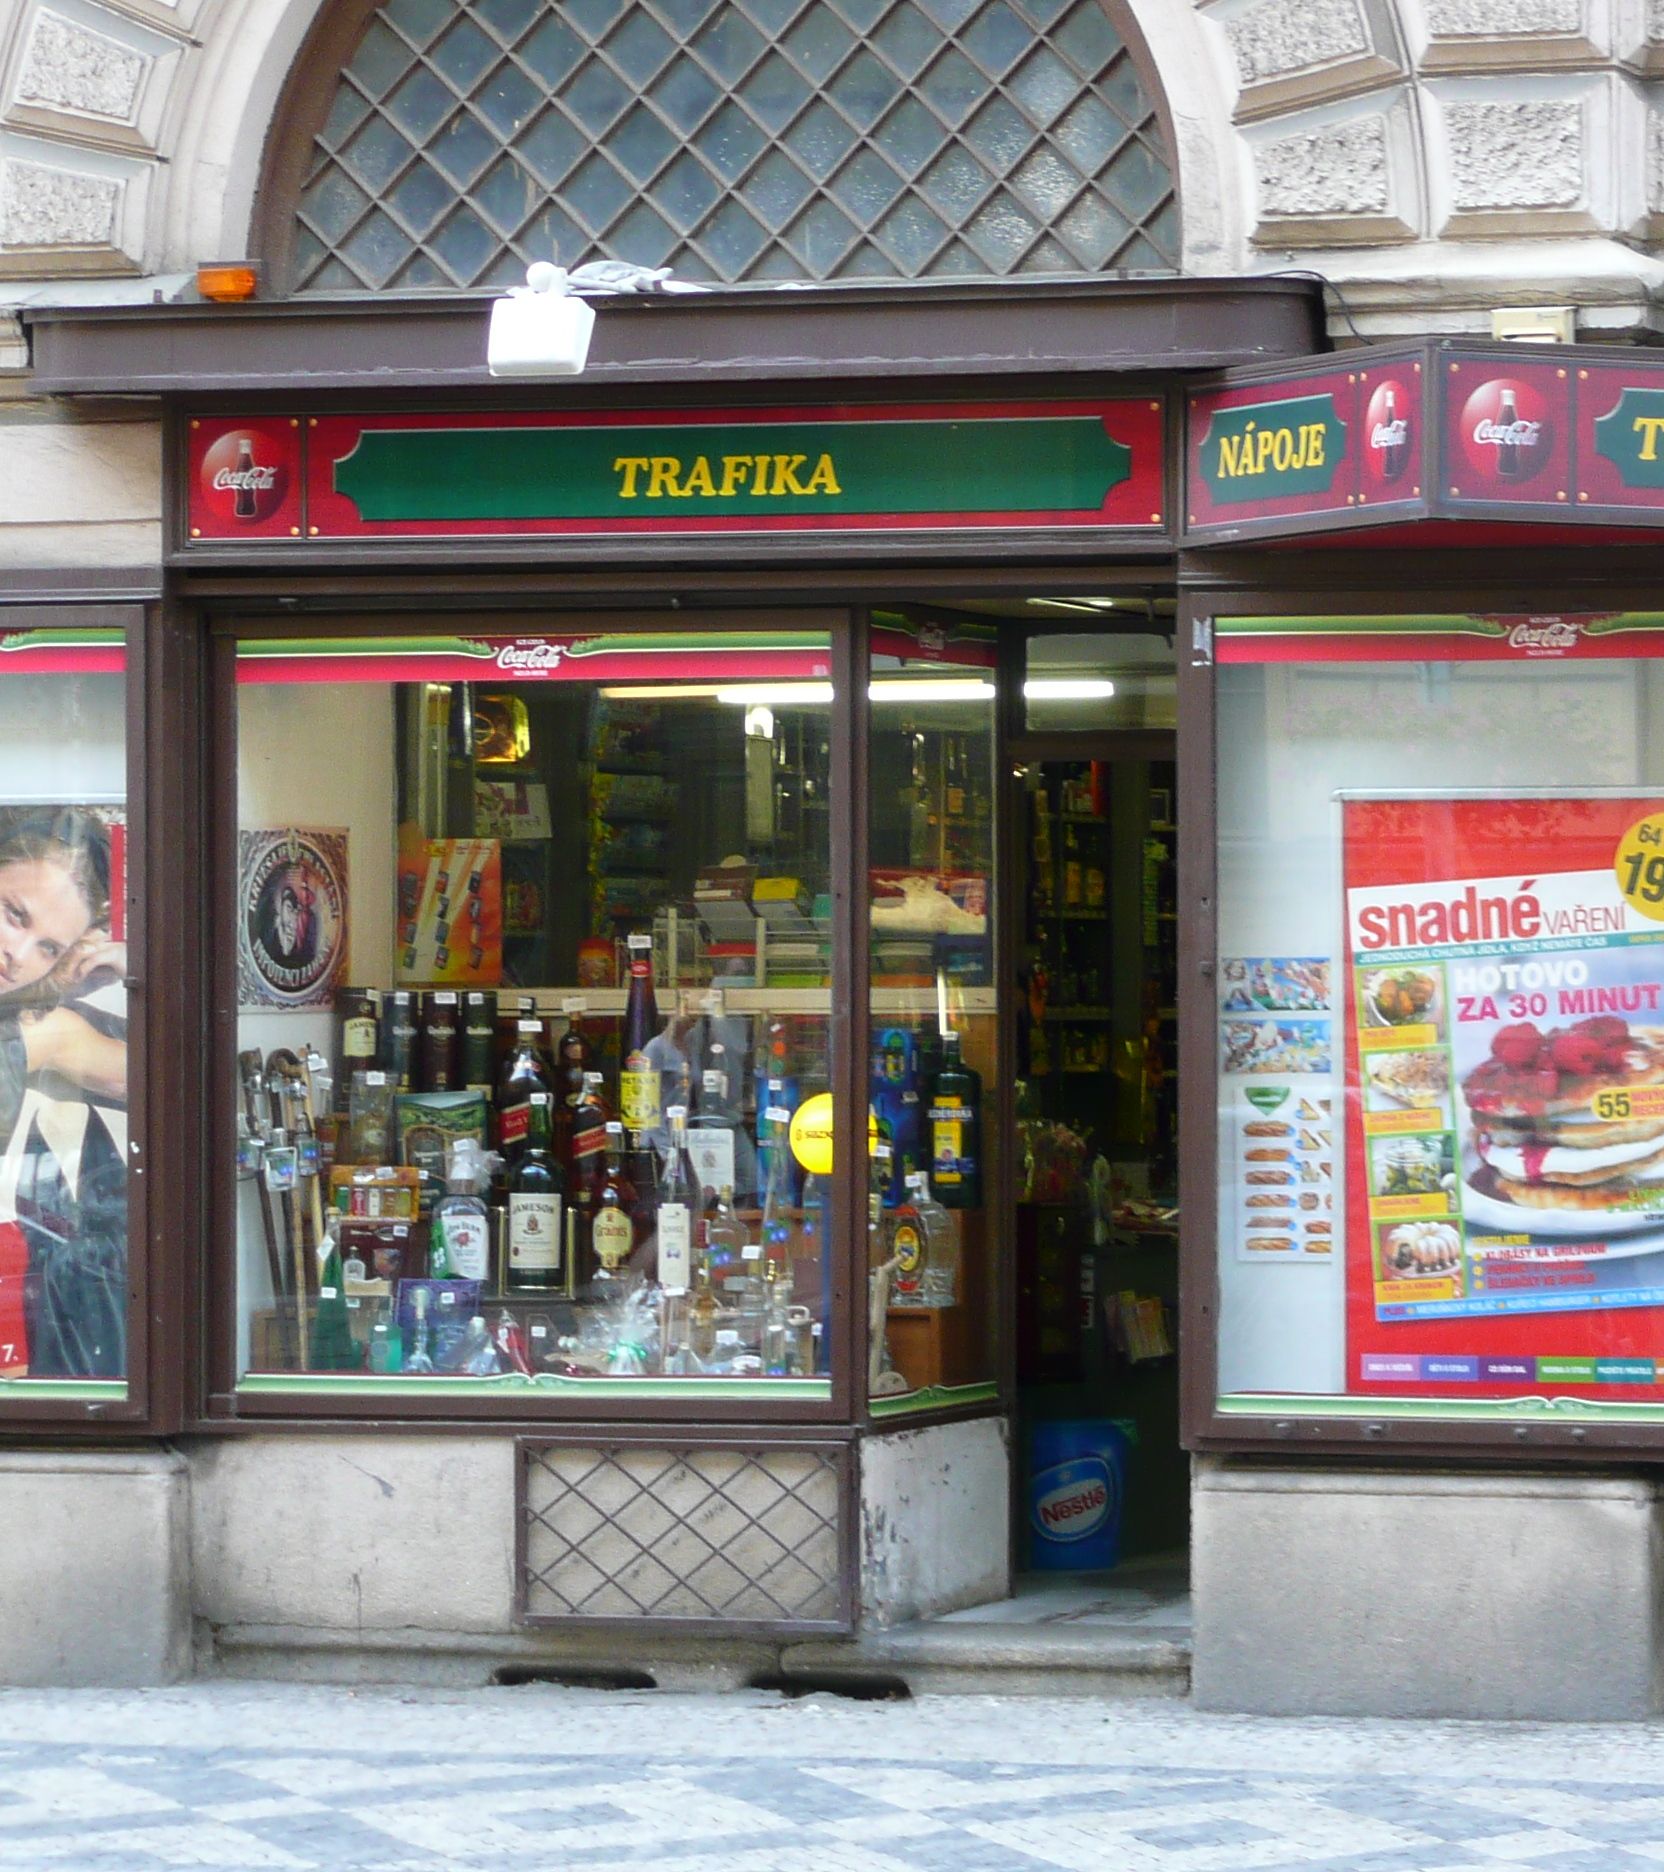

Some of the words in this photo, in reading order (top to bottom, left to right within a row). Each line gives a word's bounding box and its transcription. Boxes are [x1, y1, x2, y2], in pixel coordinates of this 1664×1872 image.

[1216, 421, 1327, 479] NÁPOJE
[613, 453, 843, 498] TRAFIKA
[1638, 823, 1663, 847] 64
[1358, 879, 1541, 950] snadné
[1541, 901, 1627, 936] VAŘENÍ
[1453, 959, 1589, 993] HOTOVO
[1456, 996, 1500, 1022] ZA
[1507, 992, 1548, 1019] 30
[1557, 983, 1663, 1016] MINUT
[1598, 1092, 1631, 1119] 55
